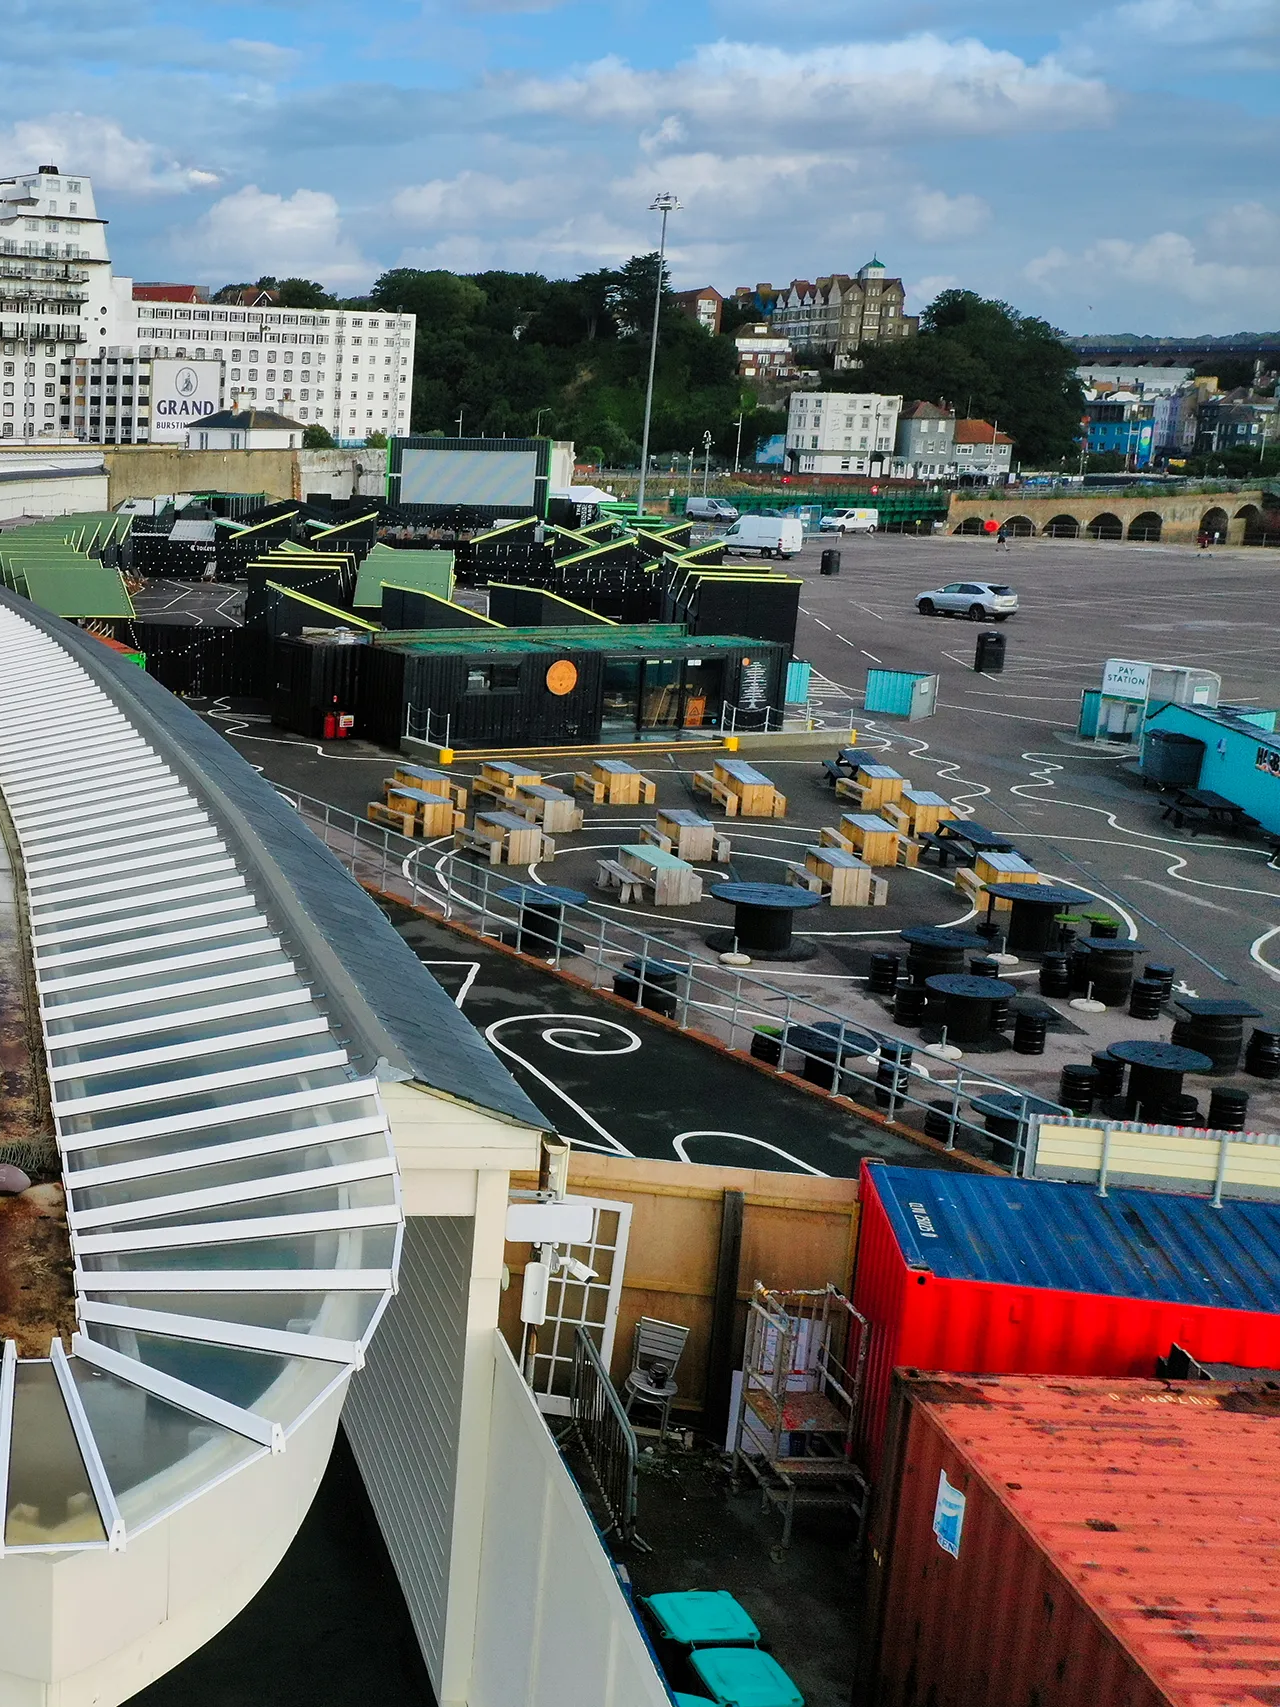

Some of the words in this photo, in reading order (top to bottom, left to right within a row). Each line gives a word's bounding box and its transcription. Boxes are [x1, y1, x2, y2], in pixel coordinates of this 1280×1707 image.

[157, 400, 214, 416] GRAND
[1118, 666, 1135, 675] PAY
[1107, 674, 1145, 686] STATION
